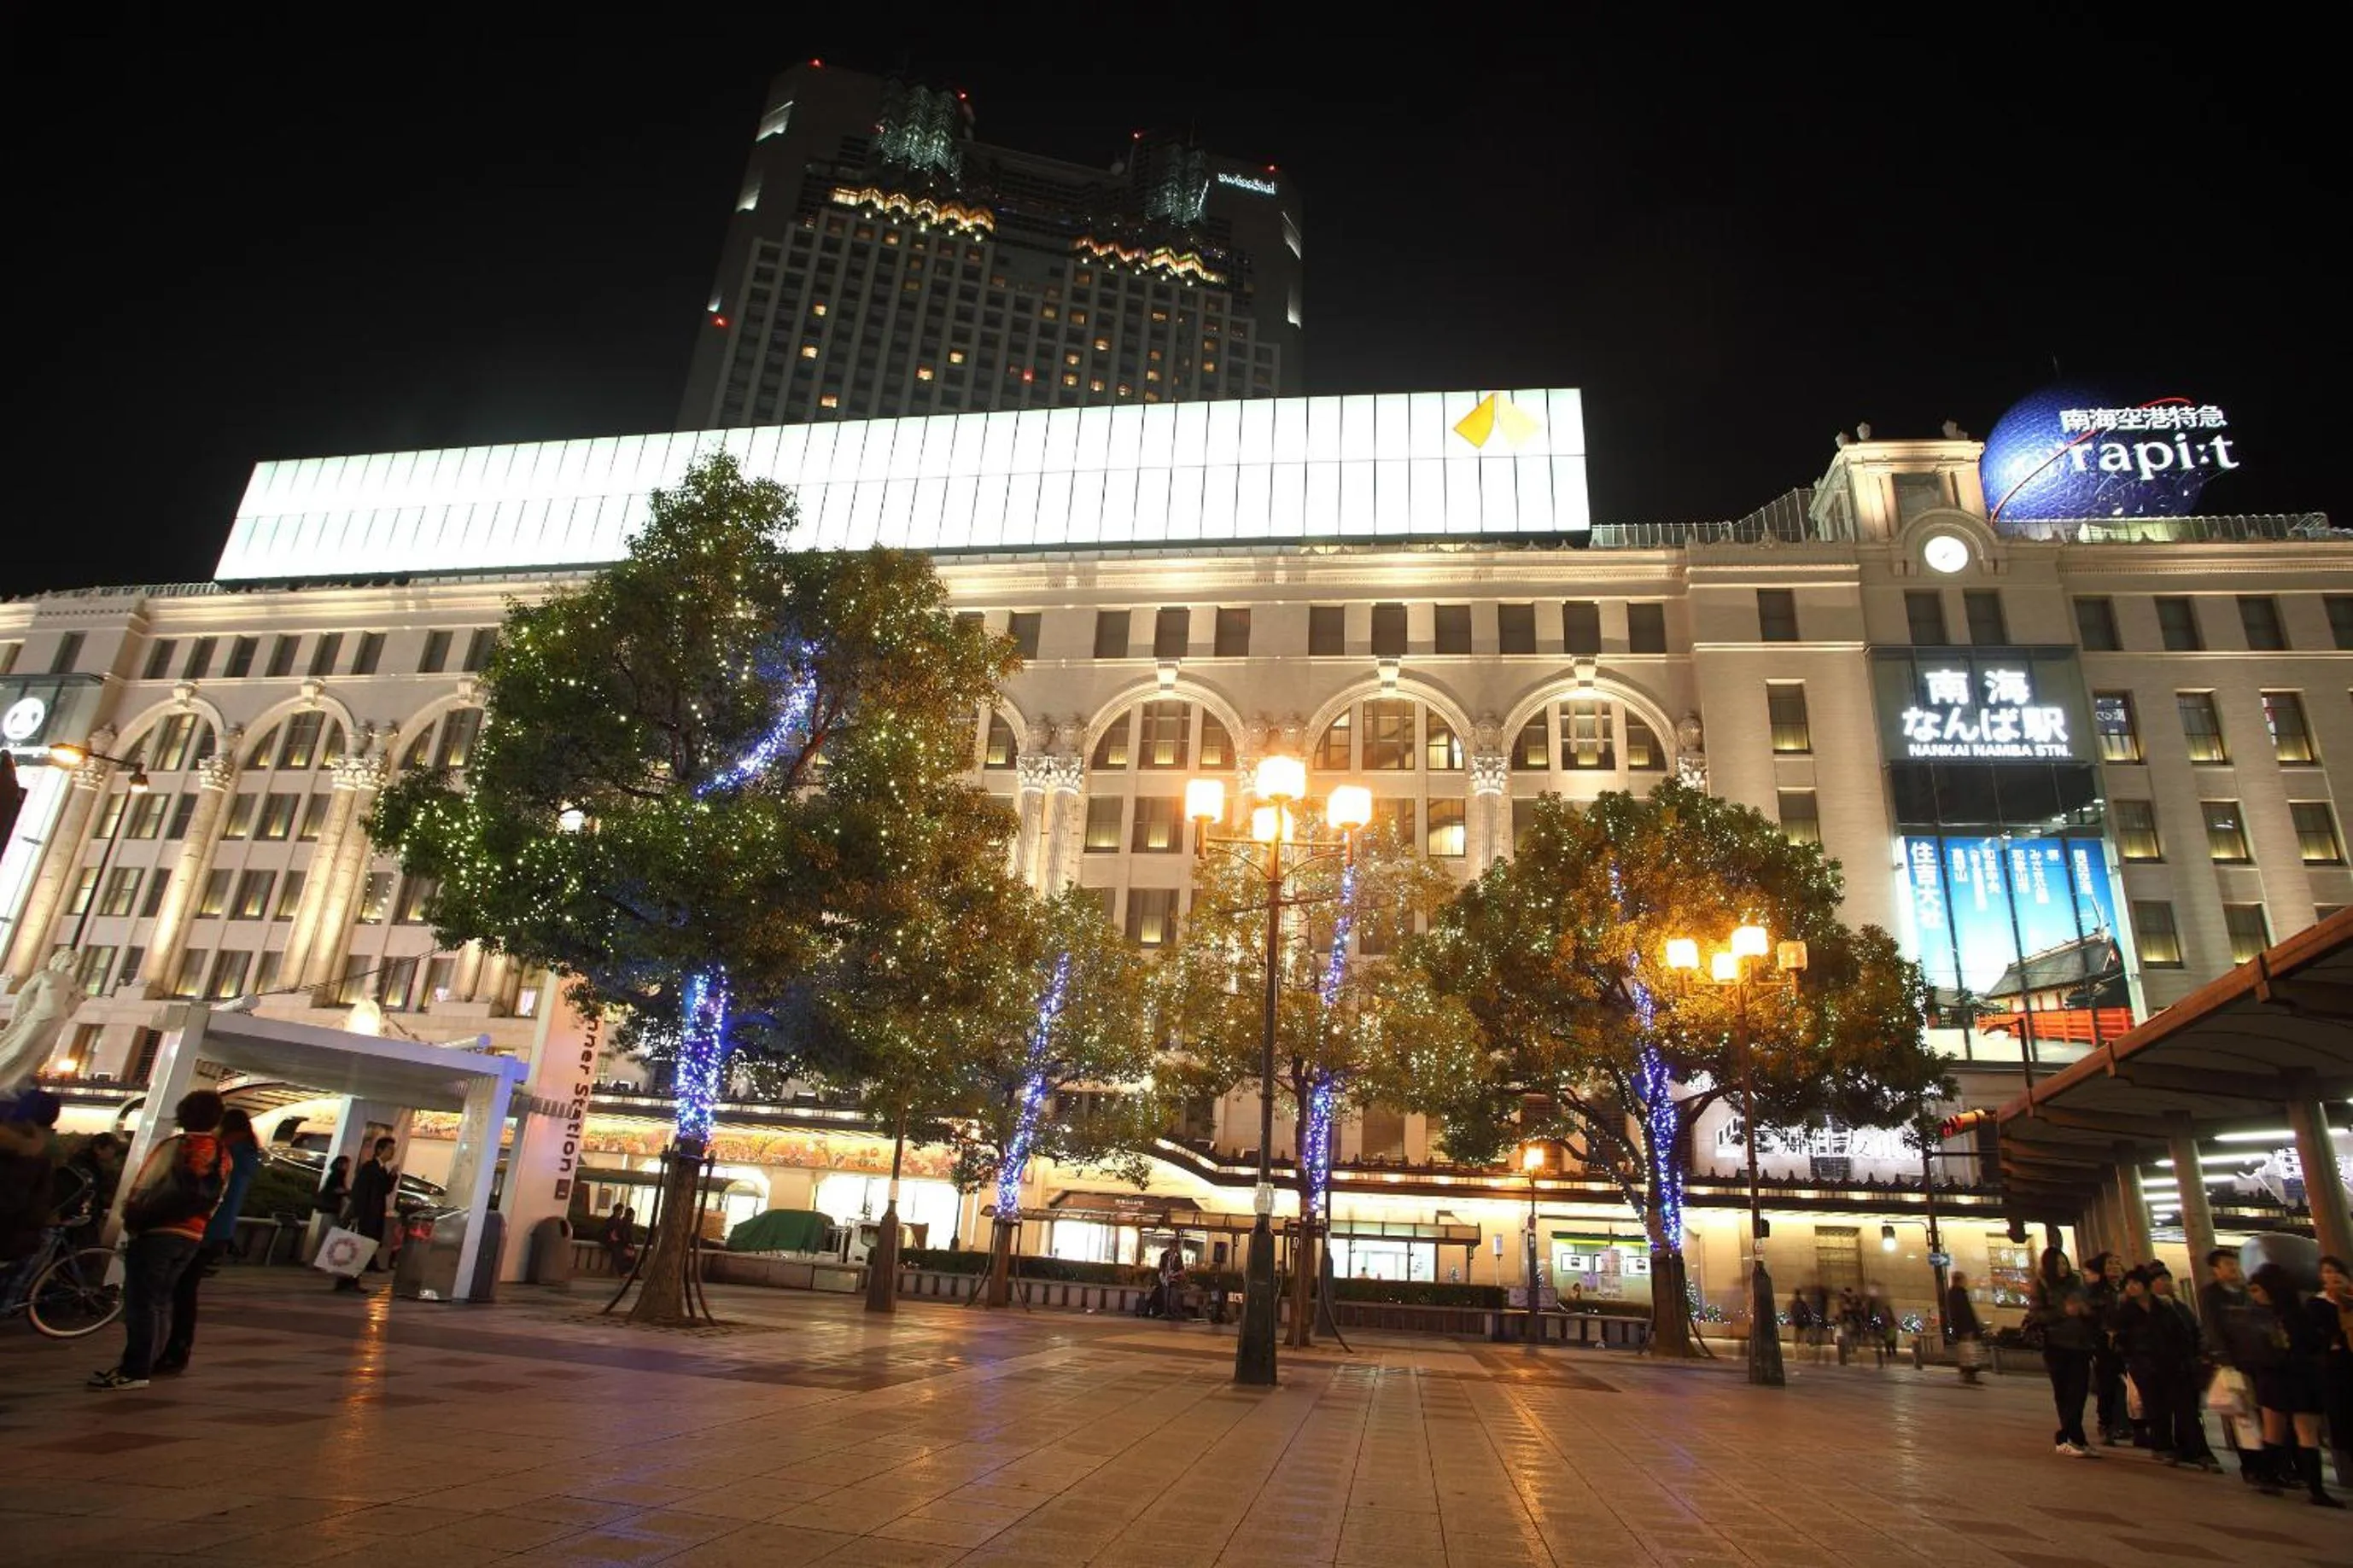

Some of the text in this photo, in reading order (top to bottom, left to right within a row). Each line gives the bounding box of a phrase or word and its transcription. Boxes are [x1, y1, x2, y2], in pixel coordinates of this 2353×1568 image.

[2059, 405, 2227, 433] 南海空港特急
[1924, 669, 2030, 705] 南海
[1901, 707, 2069, 743] なんば駅
[1908, 743, 2073, 757] NANKAI NAMBA STN.
[1911, 842, 1944, 930] 住吉大社
[559, 1082, 590, 1173] Station
